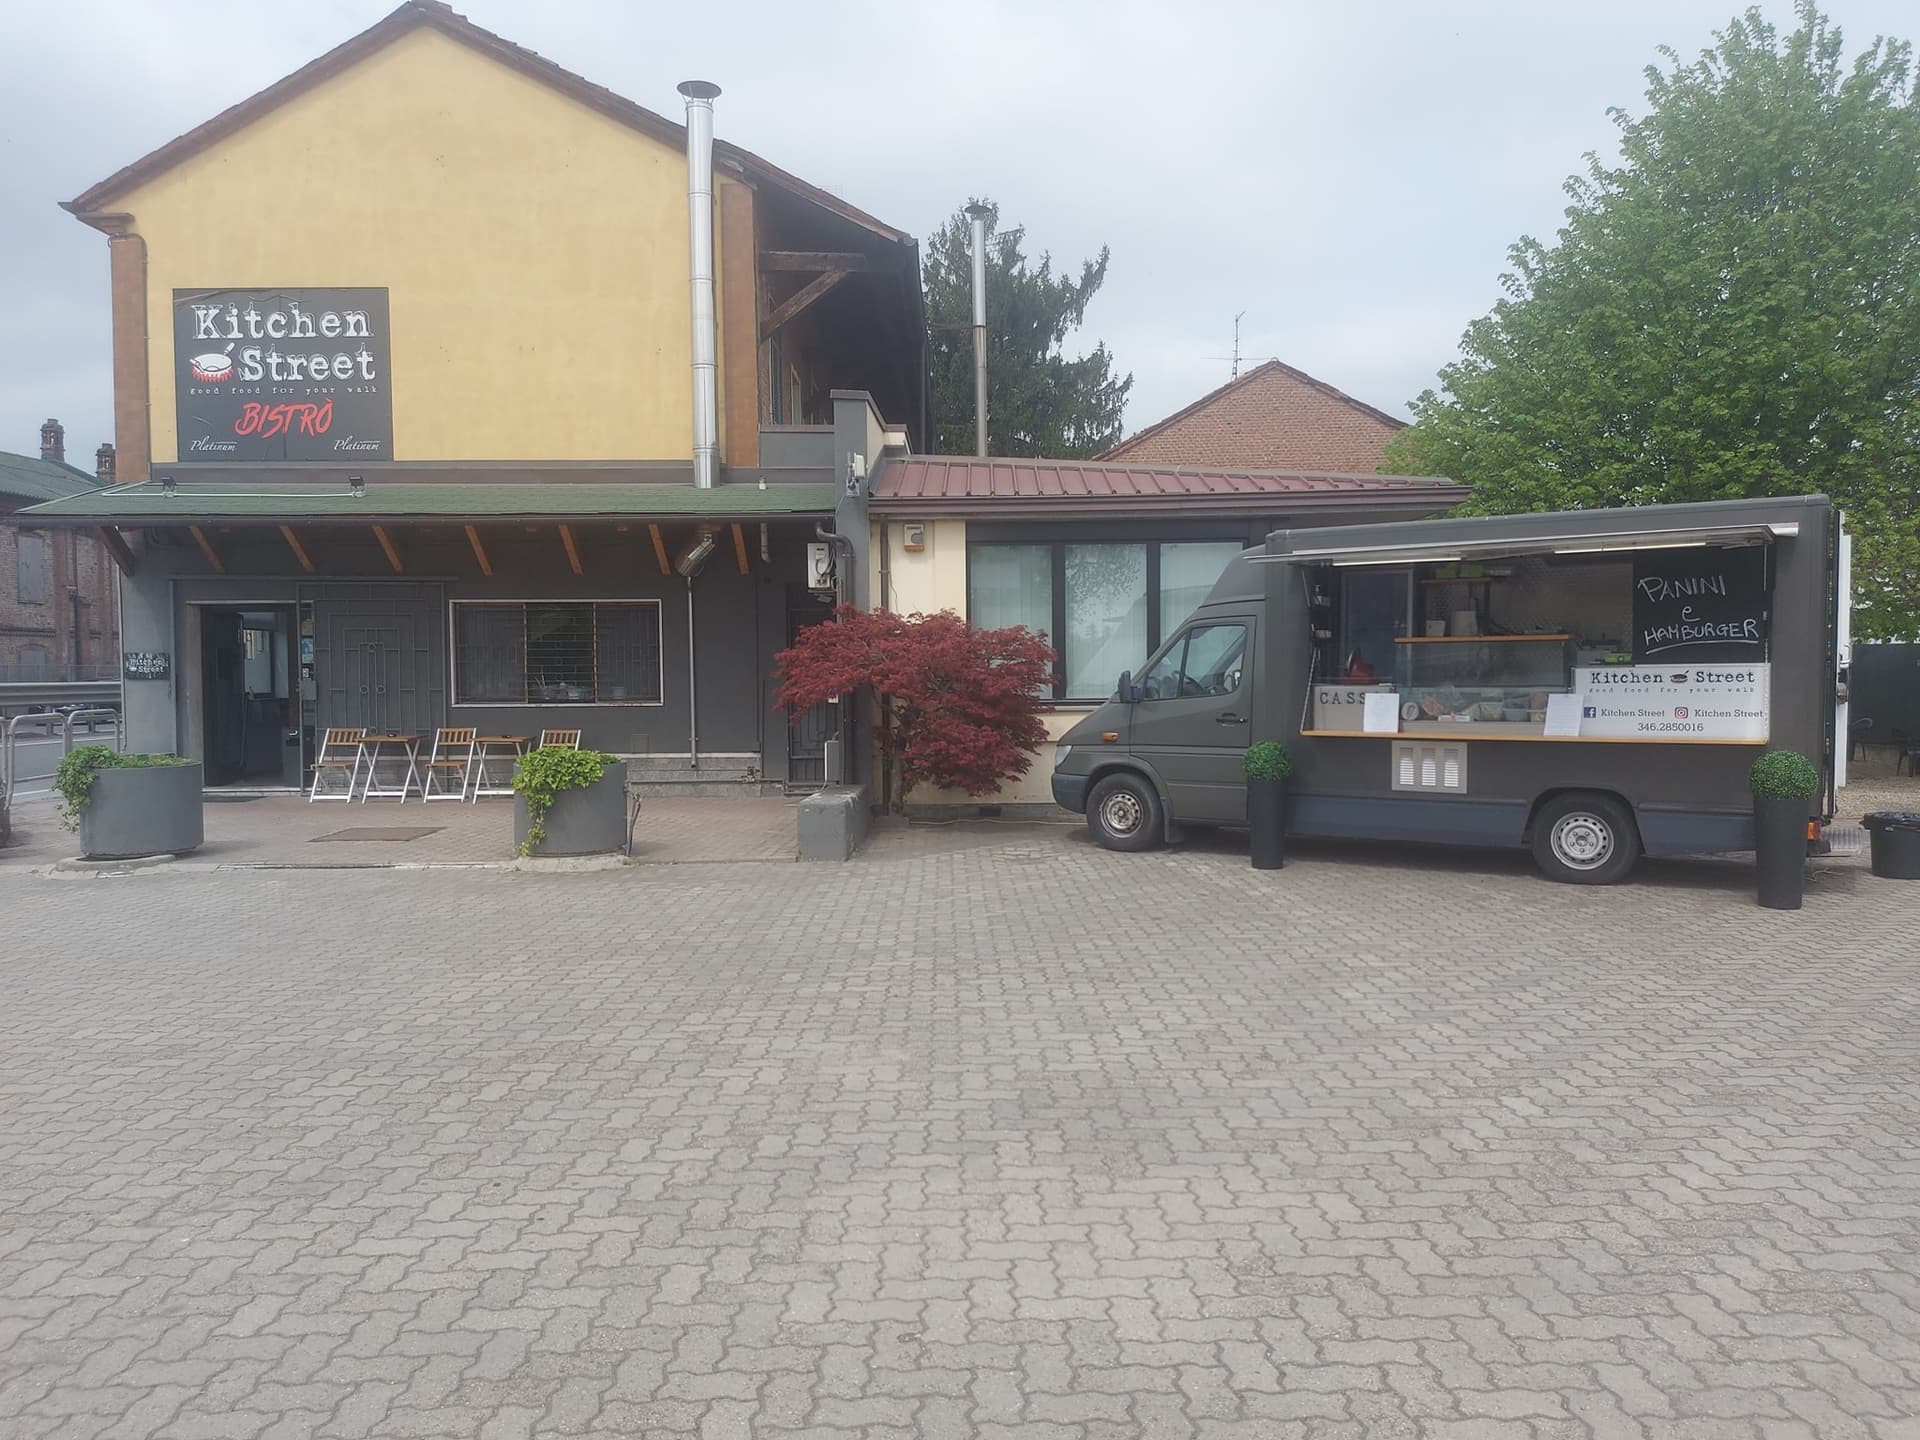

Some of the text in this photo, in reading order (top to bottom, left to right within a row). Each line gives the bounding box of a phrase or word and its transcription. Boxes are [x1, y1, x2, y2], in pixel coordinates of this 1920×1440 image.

[191, 302, 375, 339] Kitchen
[238, 342, 376, 381] Street
[190, 385, 377, 395] good food for your walk
[235, 398, 334, 439] BISTRÒ
[190, 436, 238, 452] Platinum
[334, 436, 381, 451] Platinum
[1637, 576, 1726, 602] PANINI
[1681, 606, 1700, 622] e
[1644, 618, 1759, 646] HAMBURGER
[1591, 671, 1755, 684] Kitchen Street
[1601, 708, 1635, 717] Kitchen
[1638, 708, 1665, 717] Street
[1695, 709, 1731, 718] Kitchen
[1734, 709, 1763, 718] Street
[1638, 722, 1704, 732] 346.2850016
